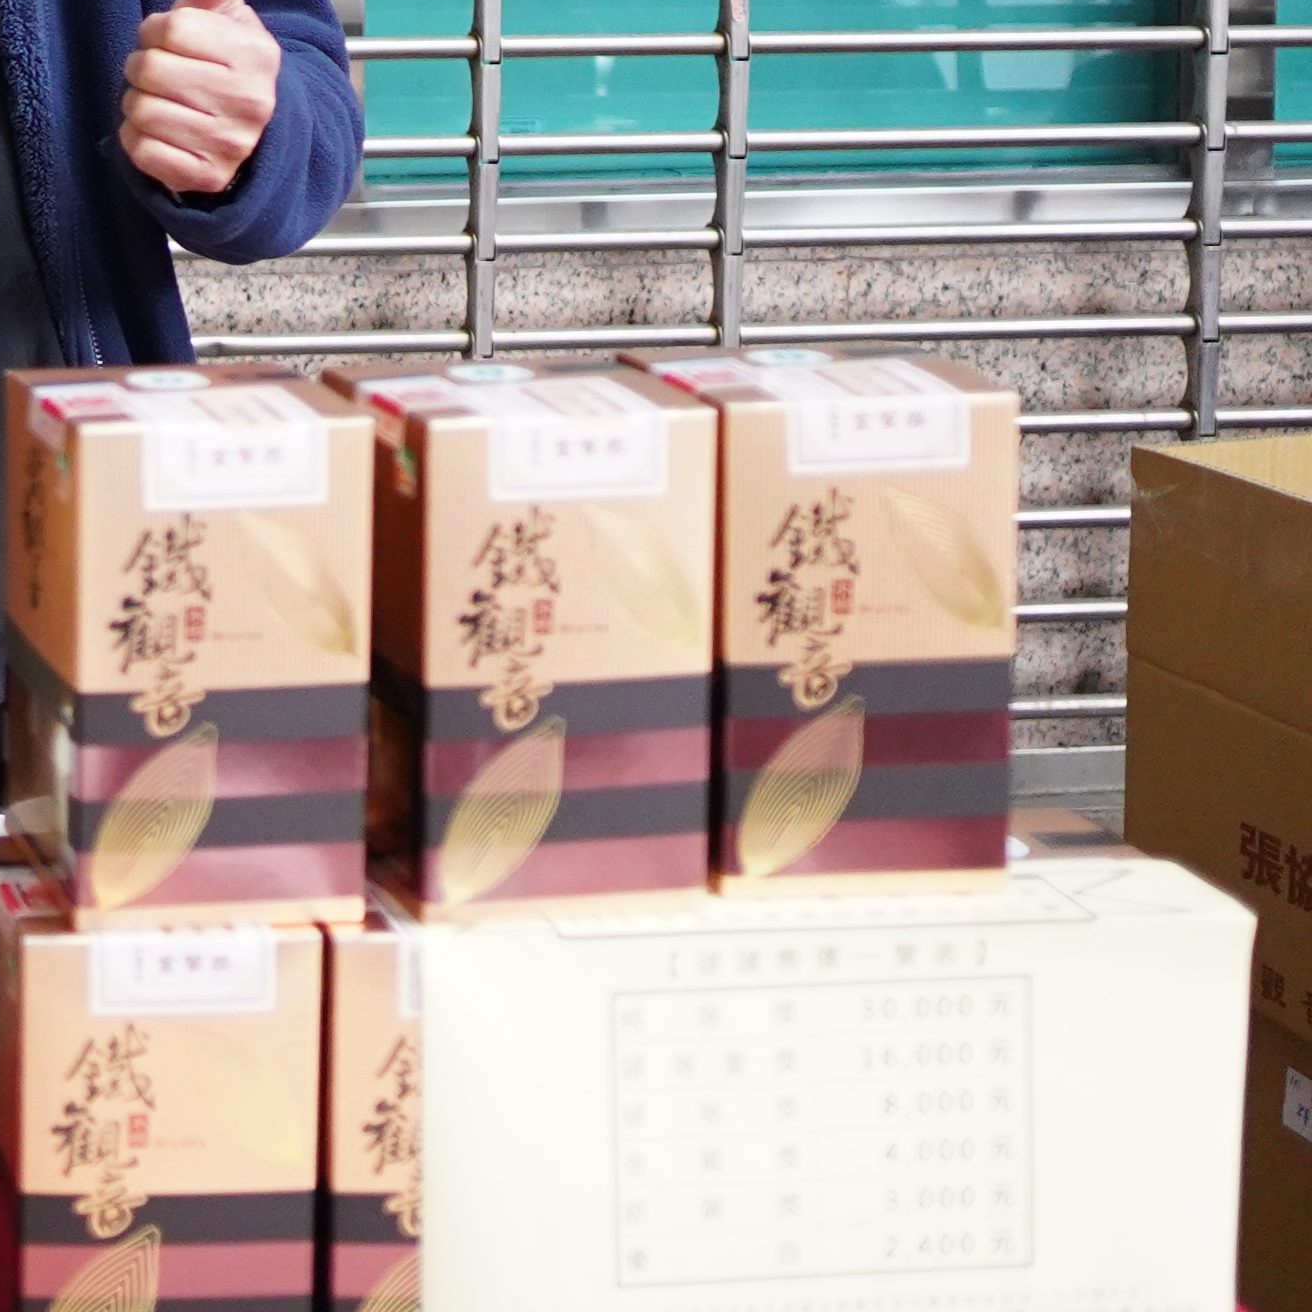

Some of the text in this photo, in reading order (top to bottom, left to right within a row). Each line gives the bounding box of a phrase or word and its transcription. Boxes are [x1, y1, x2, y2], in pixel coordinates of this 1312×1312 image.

[107, 512, 213, 739] 鐵觀音
[456, 504, 560, 734] 鐵觀音
[754, 487, 859, 713] 鐵觀音
